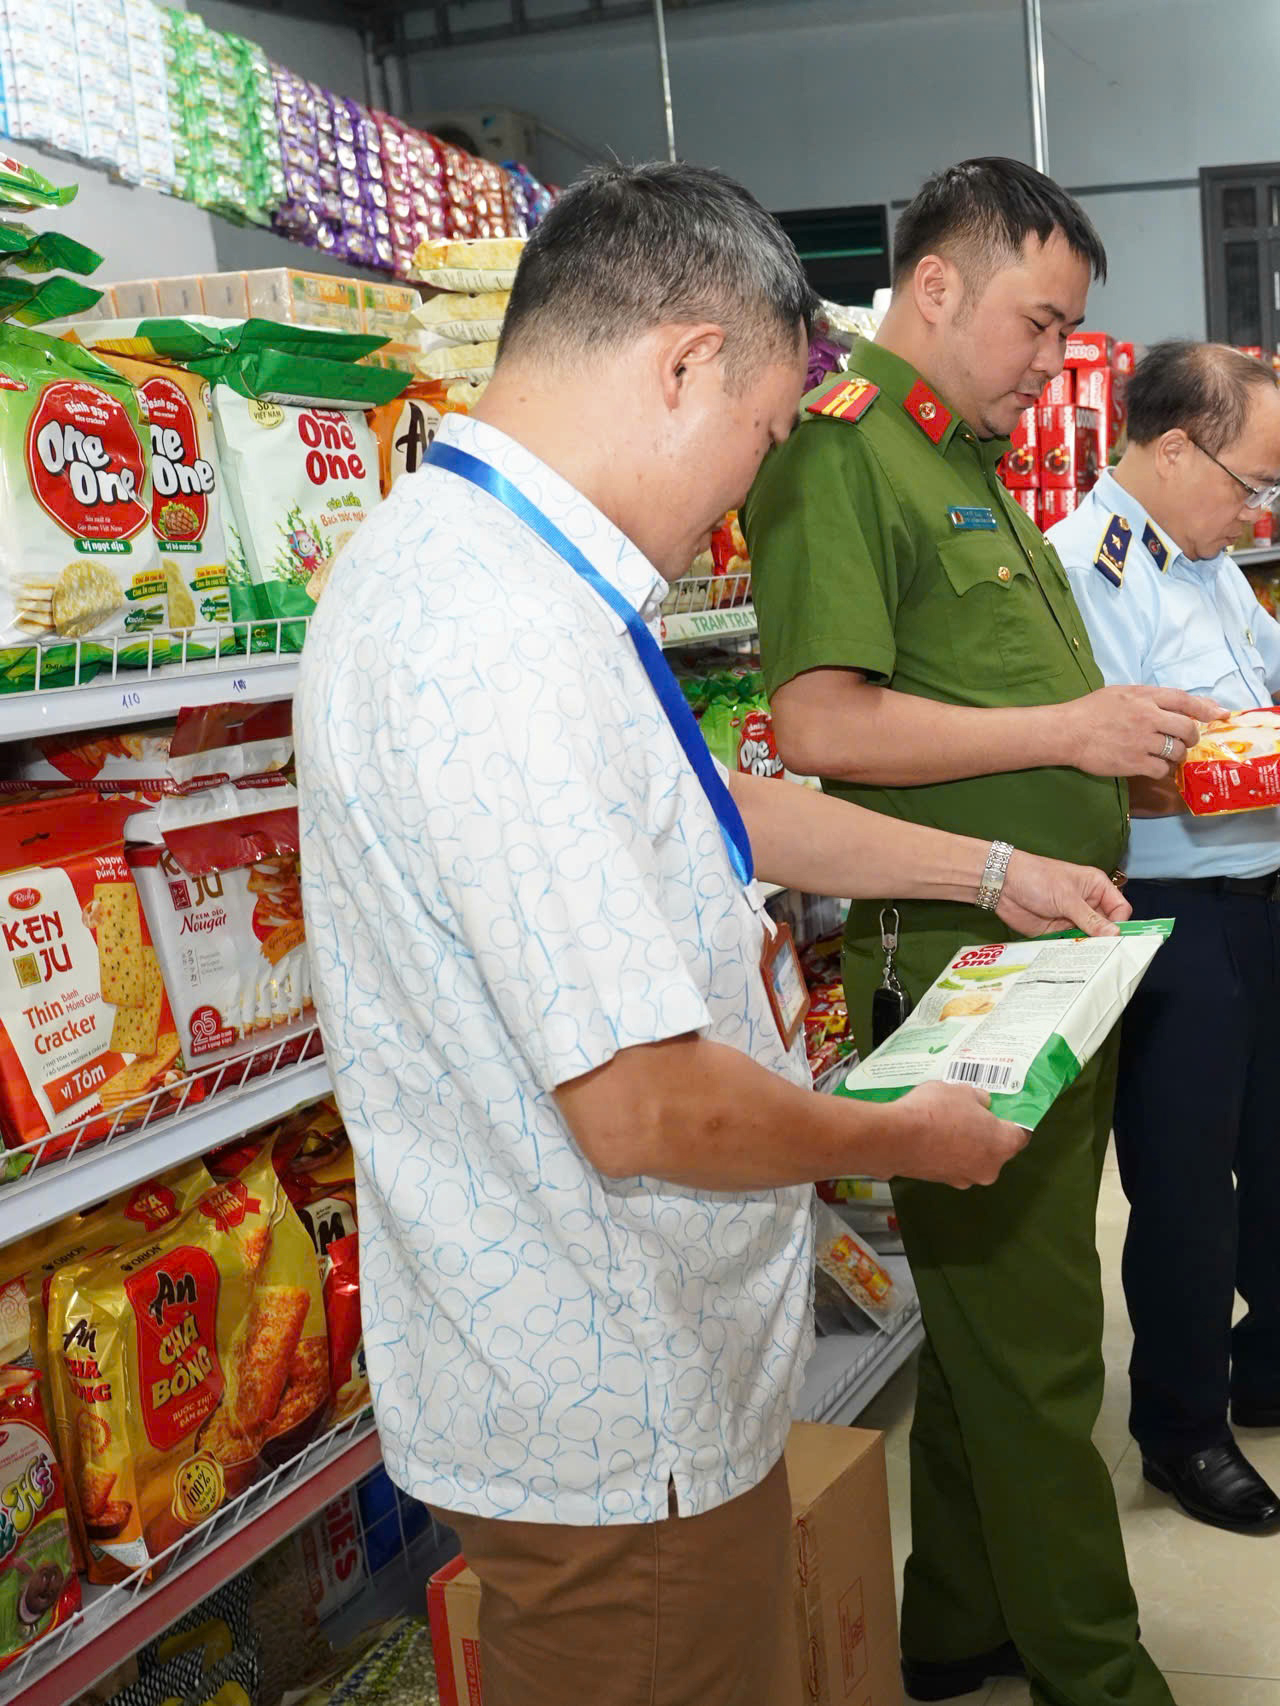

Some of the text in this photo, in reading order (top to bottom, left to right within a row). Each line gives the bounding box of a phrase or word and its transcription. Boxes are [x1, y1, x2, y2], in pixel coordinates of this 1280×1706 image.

[64, 401, 109, 420] Bánh gạo
[36, 420, 110, 474] One
[298, 413, 356, 450] One
[69, 460, 138, 506] One
[151, 453, 215, 497] One
[306, 449, 366, 485] One
[82, 541, 92, 551] Vị
[740, 738, 769, 768] One
[2, 910, 64, 952] KEN
[180, 913, 227, 936] Nougat
[39, 943, 73, 983] JU
[952, 959, 996, 970] One
[960, 950, 1003, 961] One
[22, 999, 65, 1031] Thin
[34, 1013, 96, 1055] Cracker
[60, 1064, 106, 1100] vị Tôm
[53, 1245, 87, 1266] ORION
[131, 1243, 163, 1267] ORION
[149, 1270, 198, 1325] An
[62, 1319, 97, 1352] An
[160, 1311, 200, 1365] CHÀ
[152, 1346, 213, 1410] BÔNG
[186, 1470, 211, 1508] 100%
